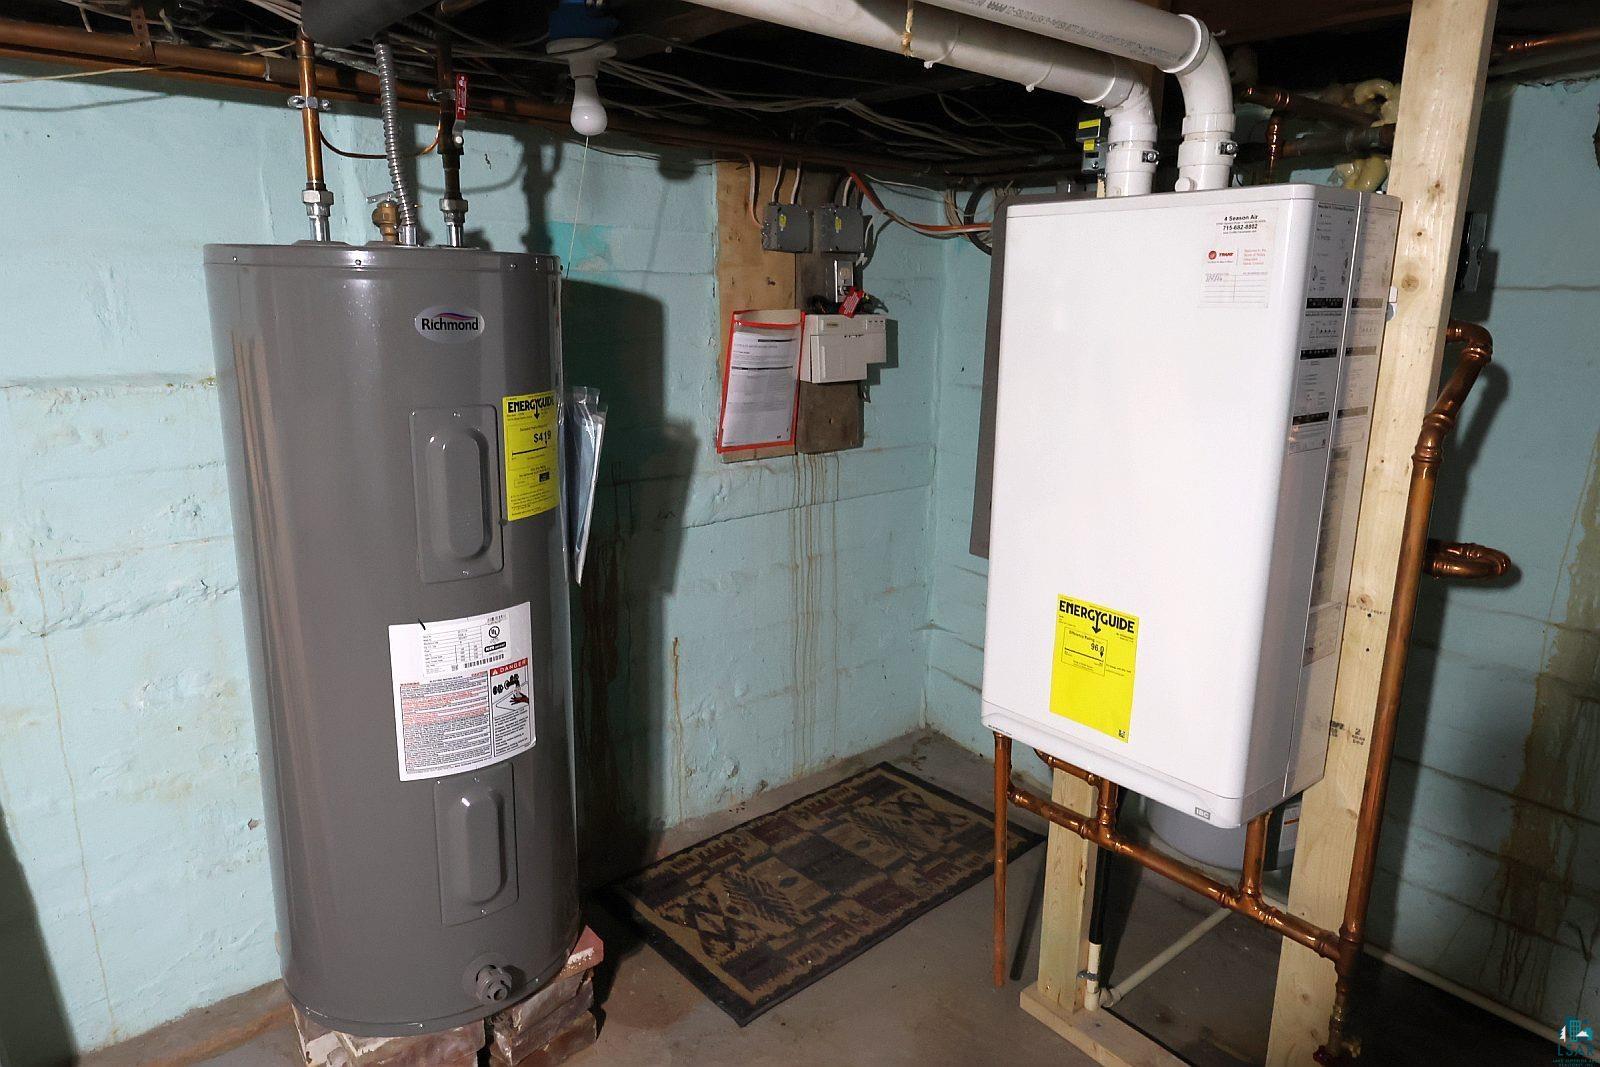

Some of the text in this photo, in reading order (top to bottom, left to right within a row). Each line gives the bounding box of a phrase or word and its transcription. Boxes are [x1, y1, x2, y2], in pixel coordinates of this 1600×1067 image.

[421, 316, 479, 331] Richmond
[1059, 599, 1135, 634] ENERGYGUIDE
[500, 660, 527, 673] DANGER
